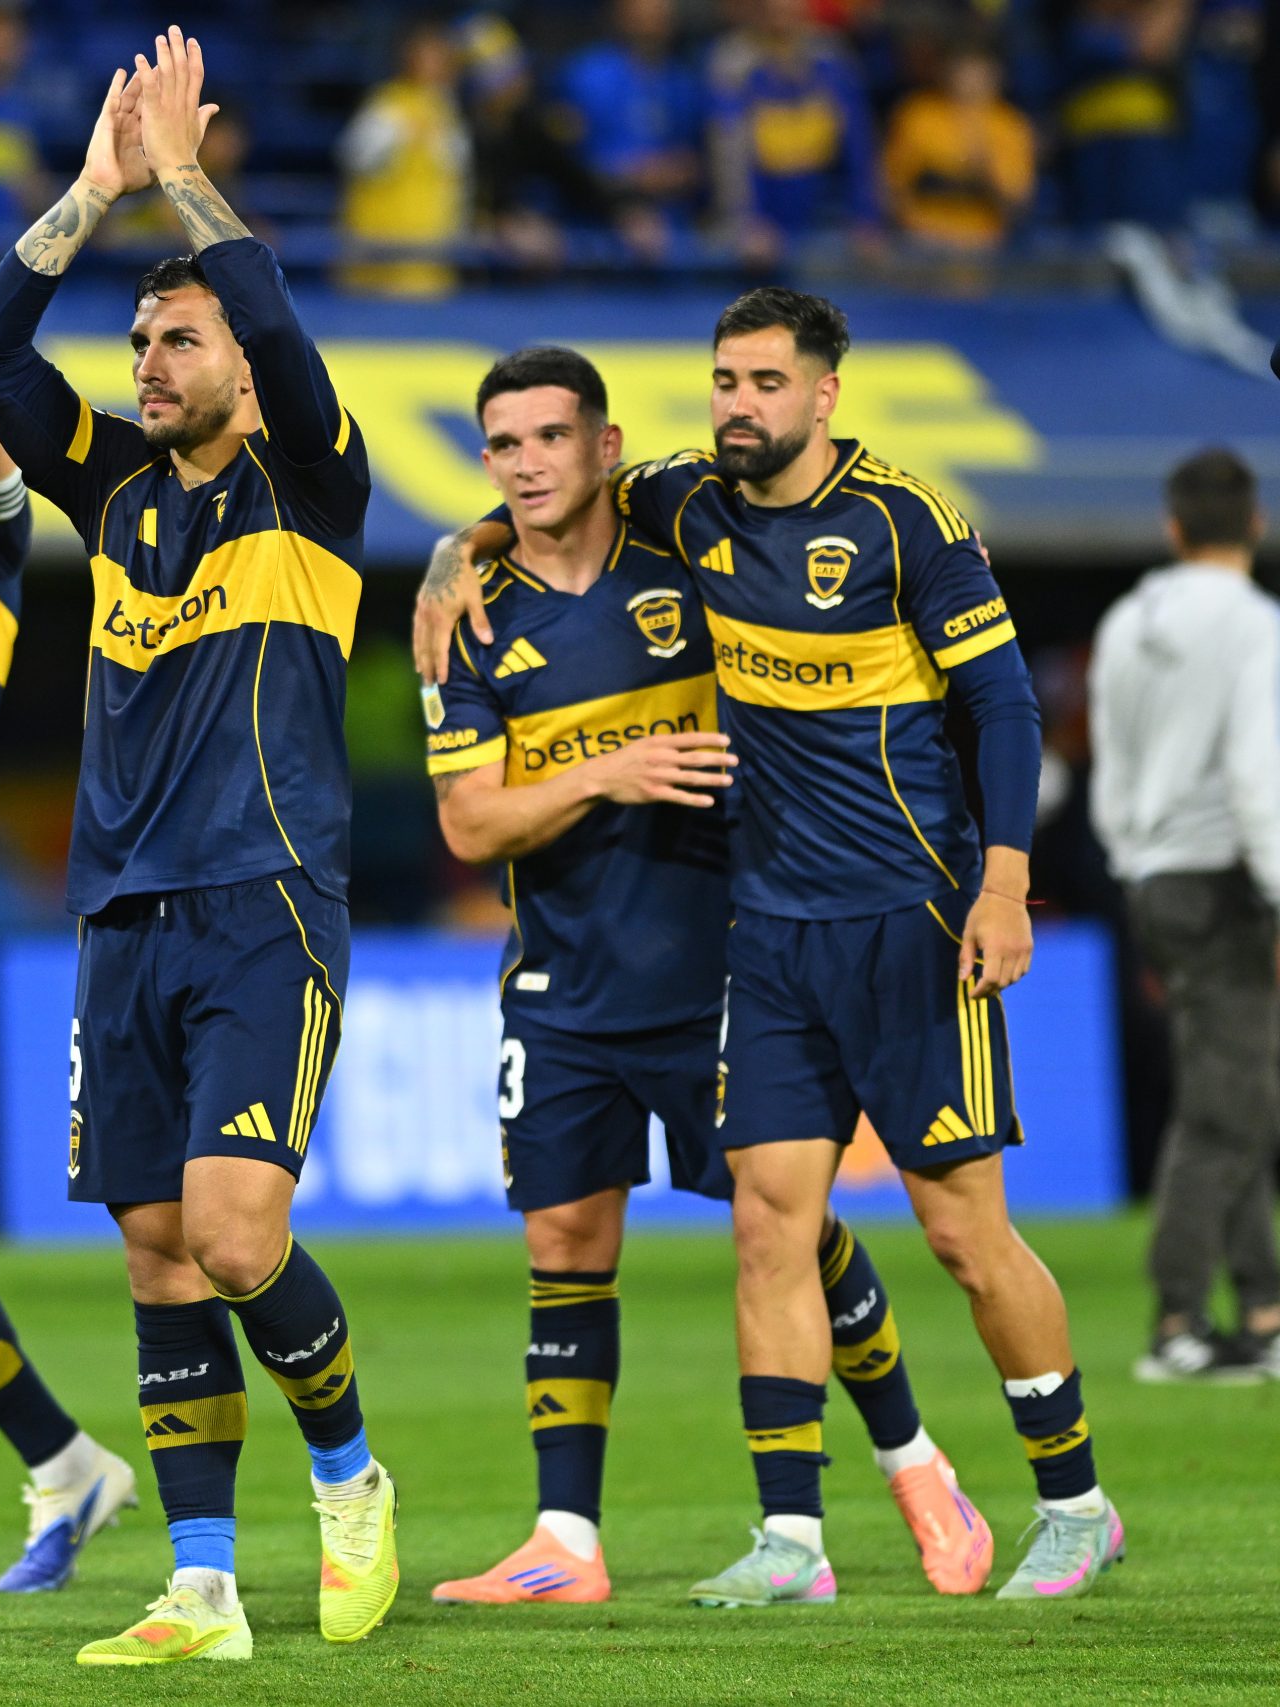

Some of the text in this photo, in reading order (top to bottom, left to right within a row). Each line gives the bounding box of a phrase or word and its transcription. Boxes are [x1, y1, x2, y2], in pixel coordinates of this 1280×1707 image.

[716, 641, 854, 686] etsson
[521, 710, 700, 772] betsson
[498, 1037, 527, 1119] 3
[265, 1316, 339, 1363] CABJ
[138, 1363, 209, 1385] CABJ
